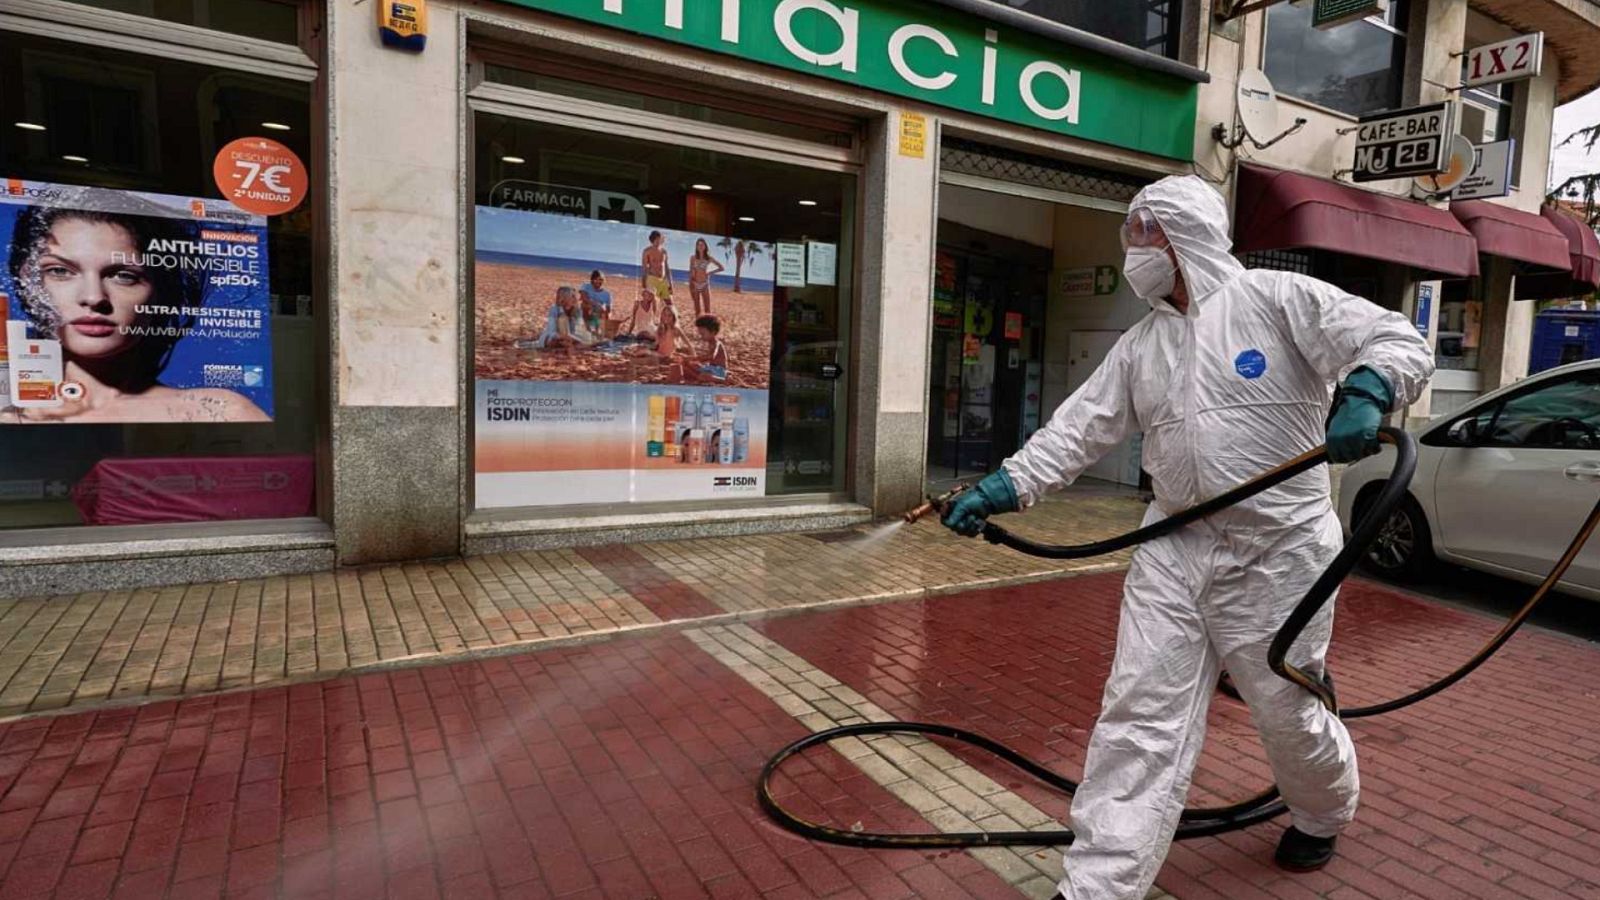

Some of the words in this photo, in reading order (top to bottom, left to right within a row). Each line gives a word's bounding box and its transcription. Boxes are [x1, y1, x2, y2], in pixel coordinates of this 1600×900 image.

[1359, 115, 1440, 142] CAFE-BAR
[231, 151, 292, 167] DESCUENTO
[1399, 141, 1430, 164] 28
[232, 160, 292, 193] -7€
[247, 190, 291, 202] UNIDAD
[503, 187, 585, 210] FARMACIA
[148, 239, 259, 258] ANTHELIOS
[111, 251, 177, 269] FLUIDO
[180, 256, 260, 274] INVISIBLE
[210, 274, 260, 287] spf50+
[134, 304, 179, 315] ULTRA
[181, 306, 261, 319] RESISTENTE
[200, 317, 261, 329] INVISIBLE
[487, 407, 530, 421] ISDIN
[733, 477, 757, 486] ISDIN
